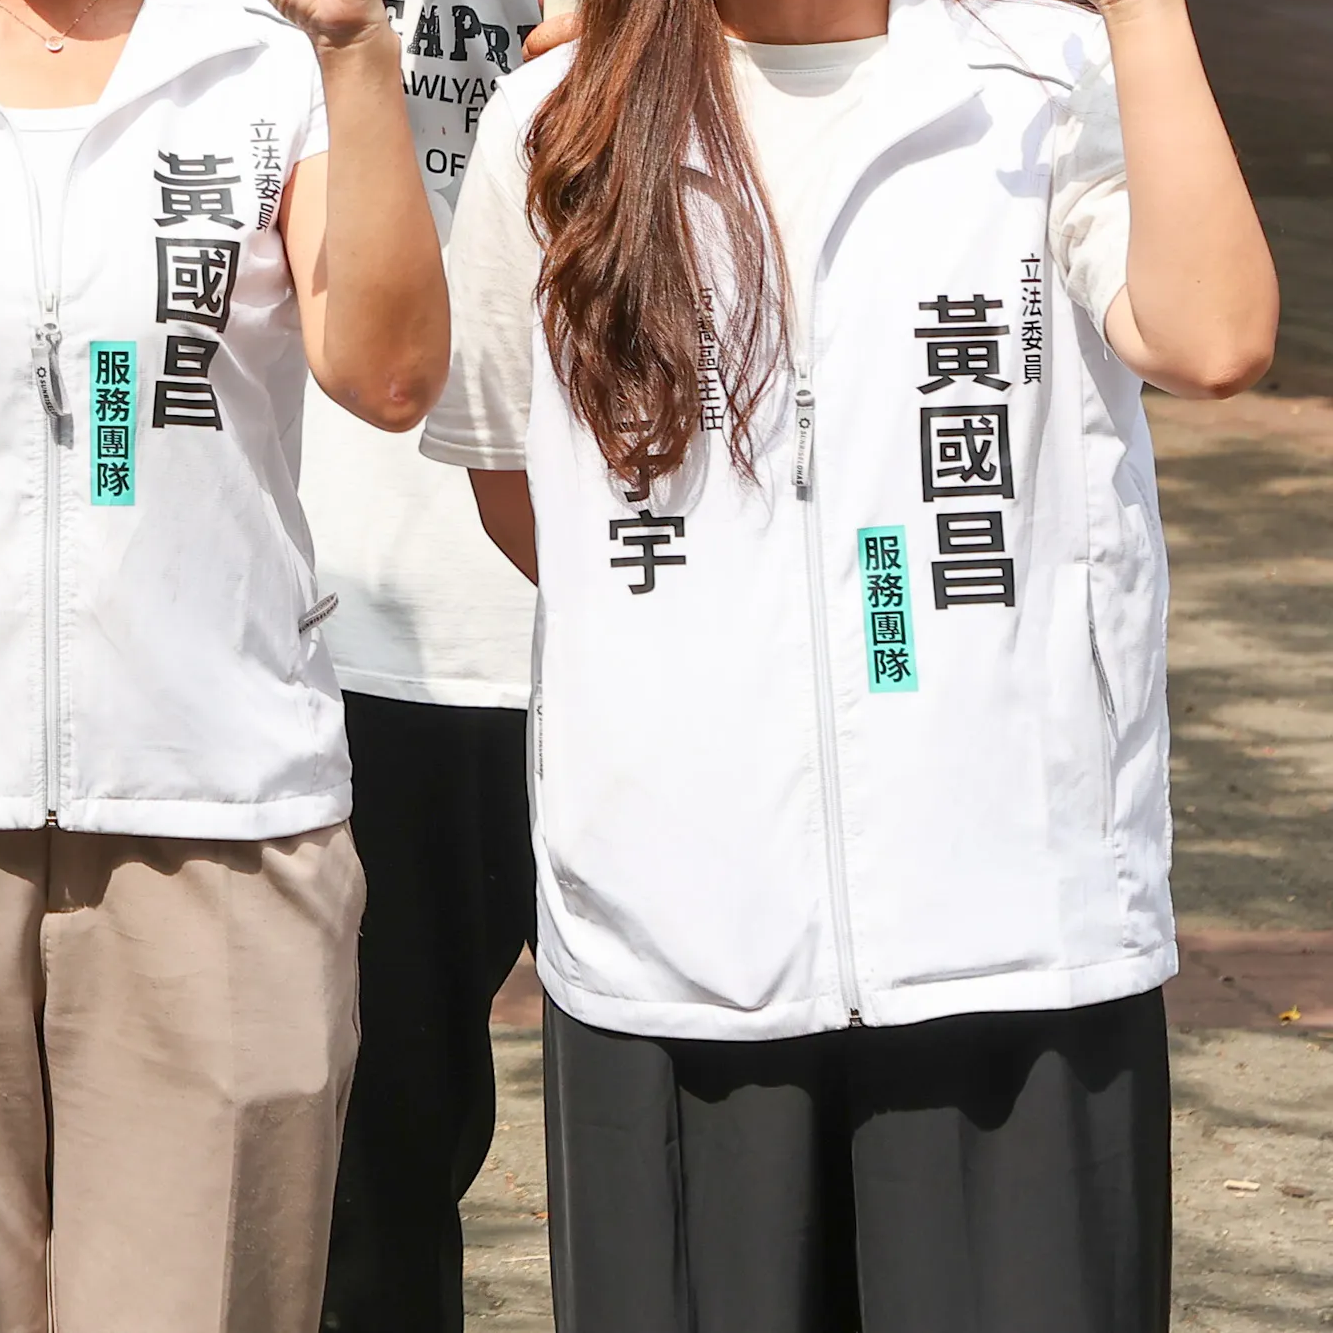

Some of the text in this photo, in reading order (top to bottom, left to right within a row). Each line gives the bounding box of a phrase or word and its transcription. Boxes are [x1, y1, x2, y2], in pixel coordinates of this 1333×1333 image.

[250, 119, 282, 233] 立法委員
[152, 149, 245, 431] 黃國昌
[1020, 253, 1043, 386] 立法委員
[95, 350, 130, 497] 服務團隊
[914, 293, 1016, 610] 黃國昌
[864, 535, 912, 684] 服務團隊
